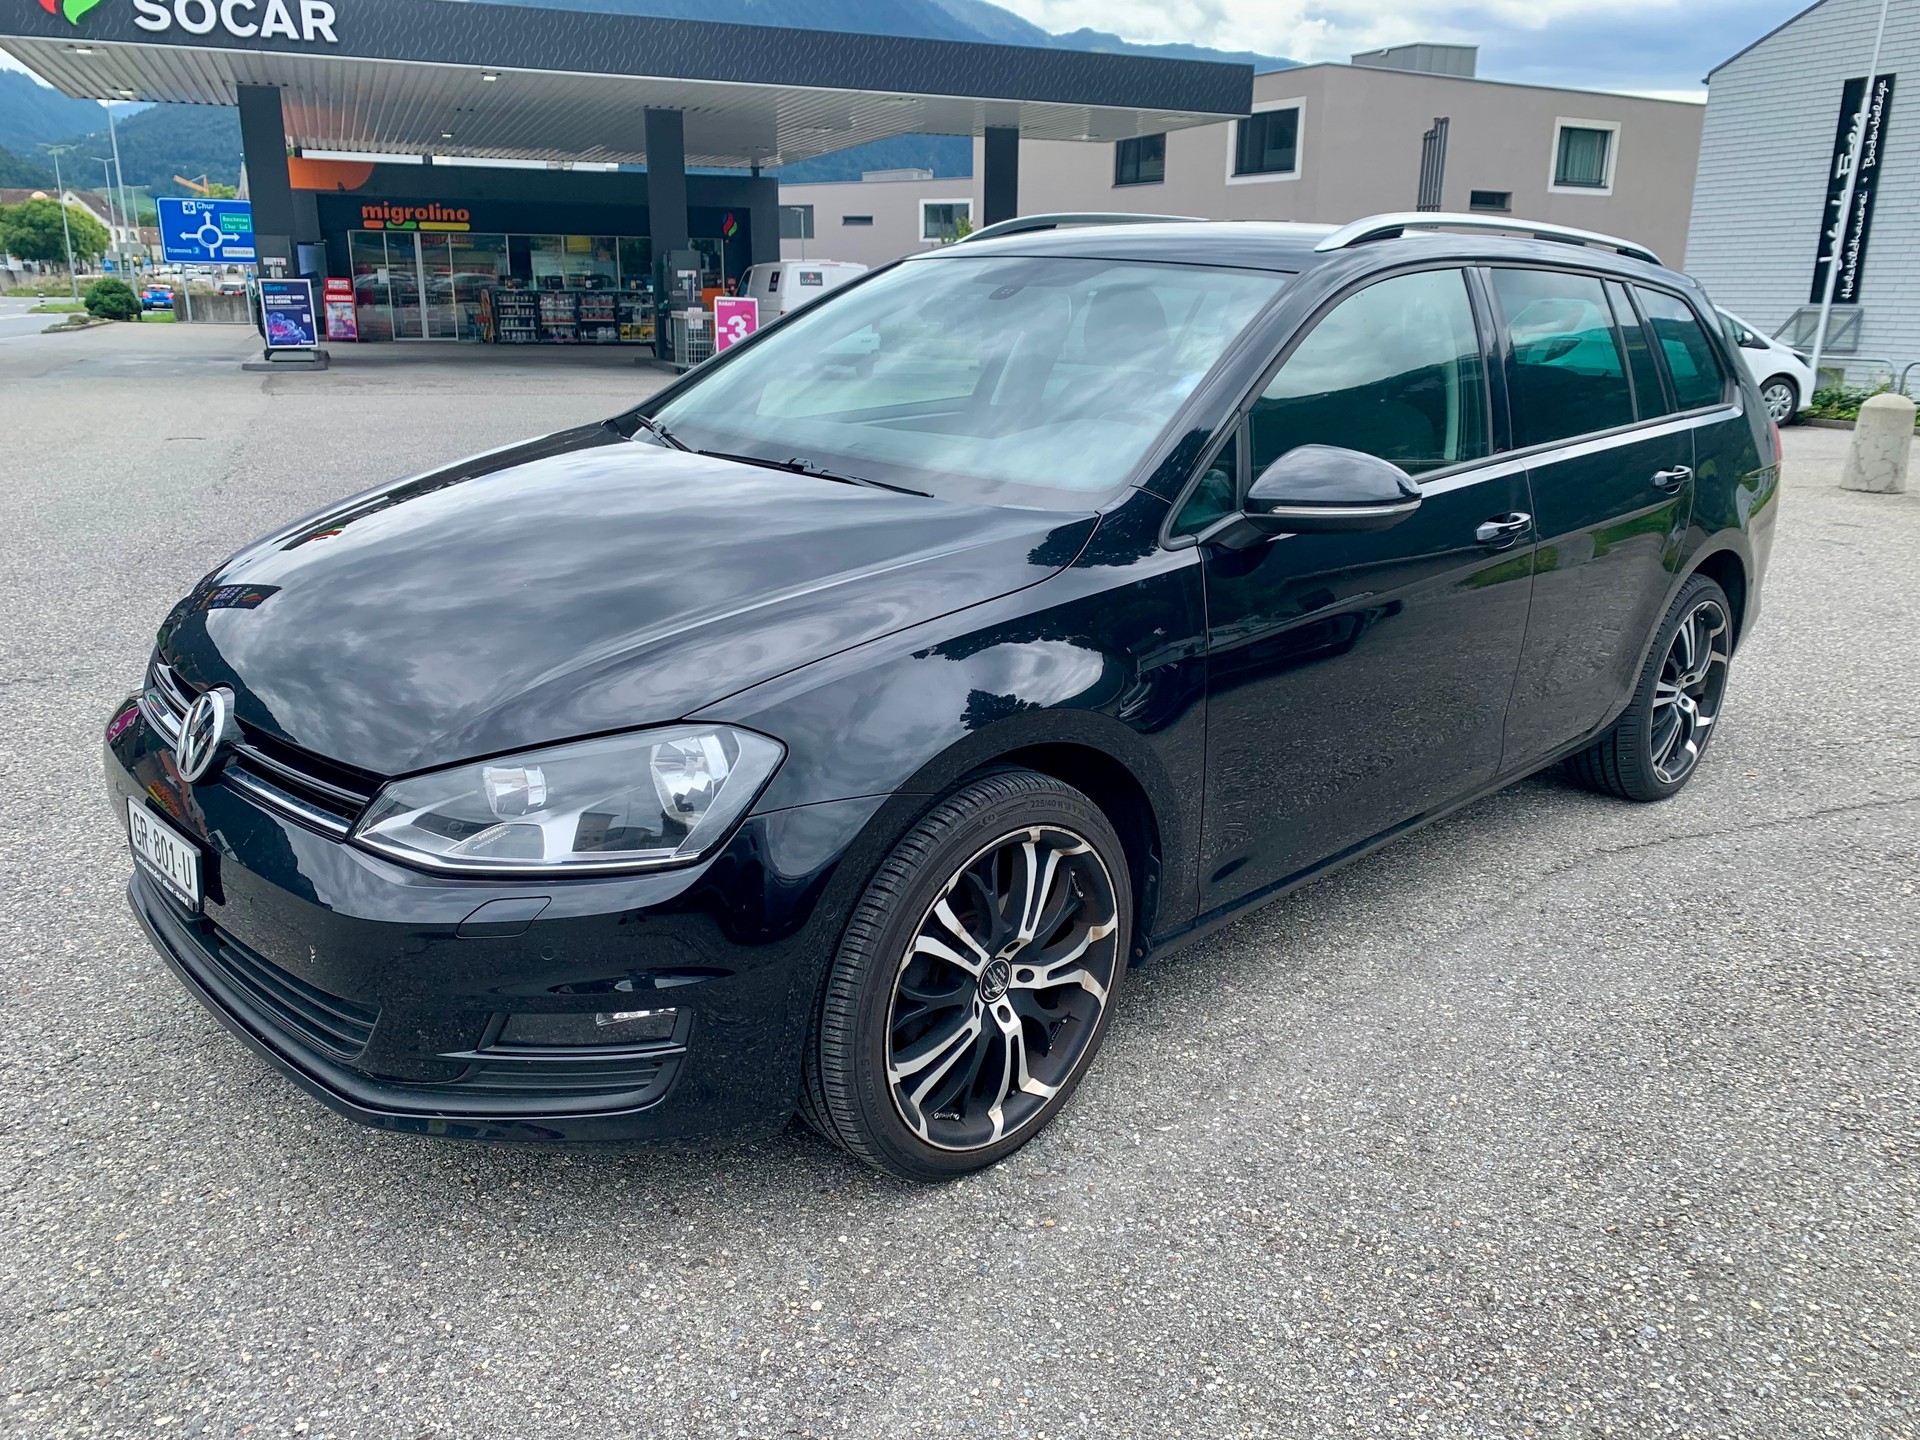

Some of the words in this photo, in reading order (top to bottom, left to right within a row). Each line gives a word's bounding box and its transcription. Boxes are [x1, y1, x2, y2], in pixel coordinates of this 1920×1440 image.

[133, 0, 338, 42] SOCAR
[1862, 80, 1889, 170] Bodenbeläge
[362, 201, 469, 225] migrolino
